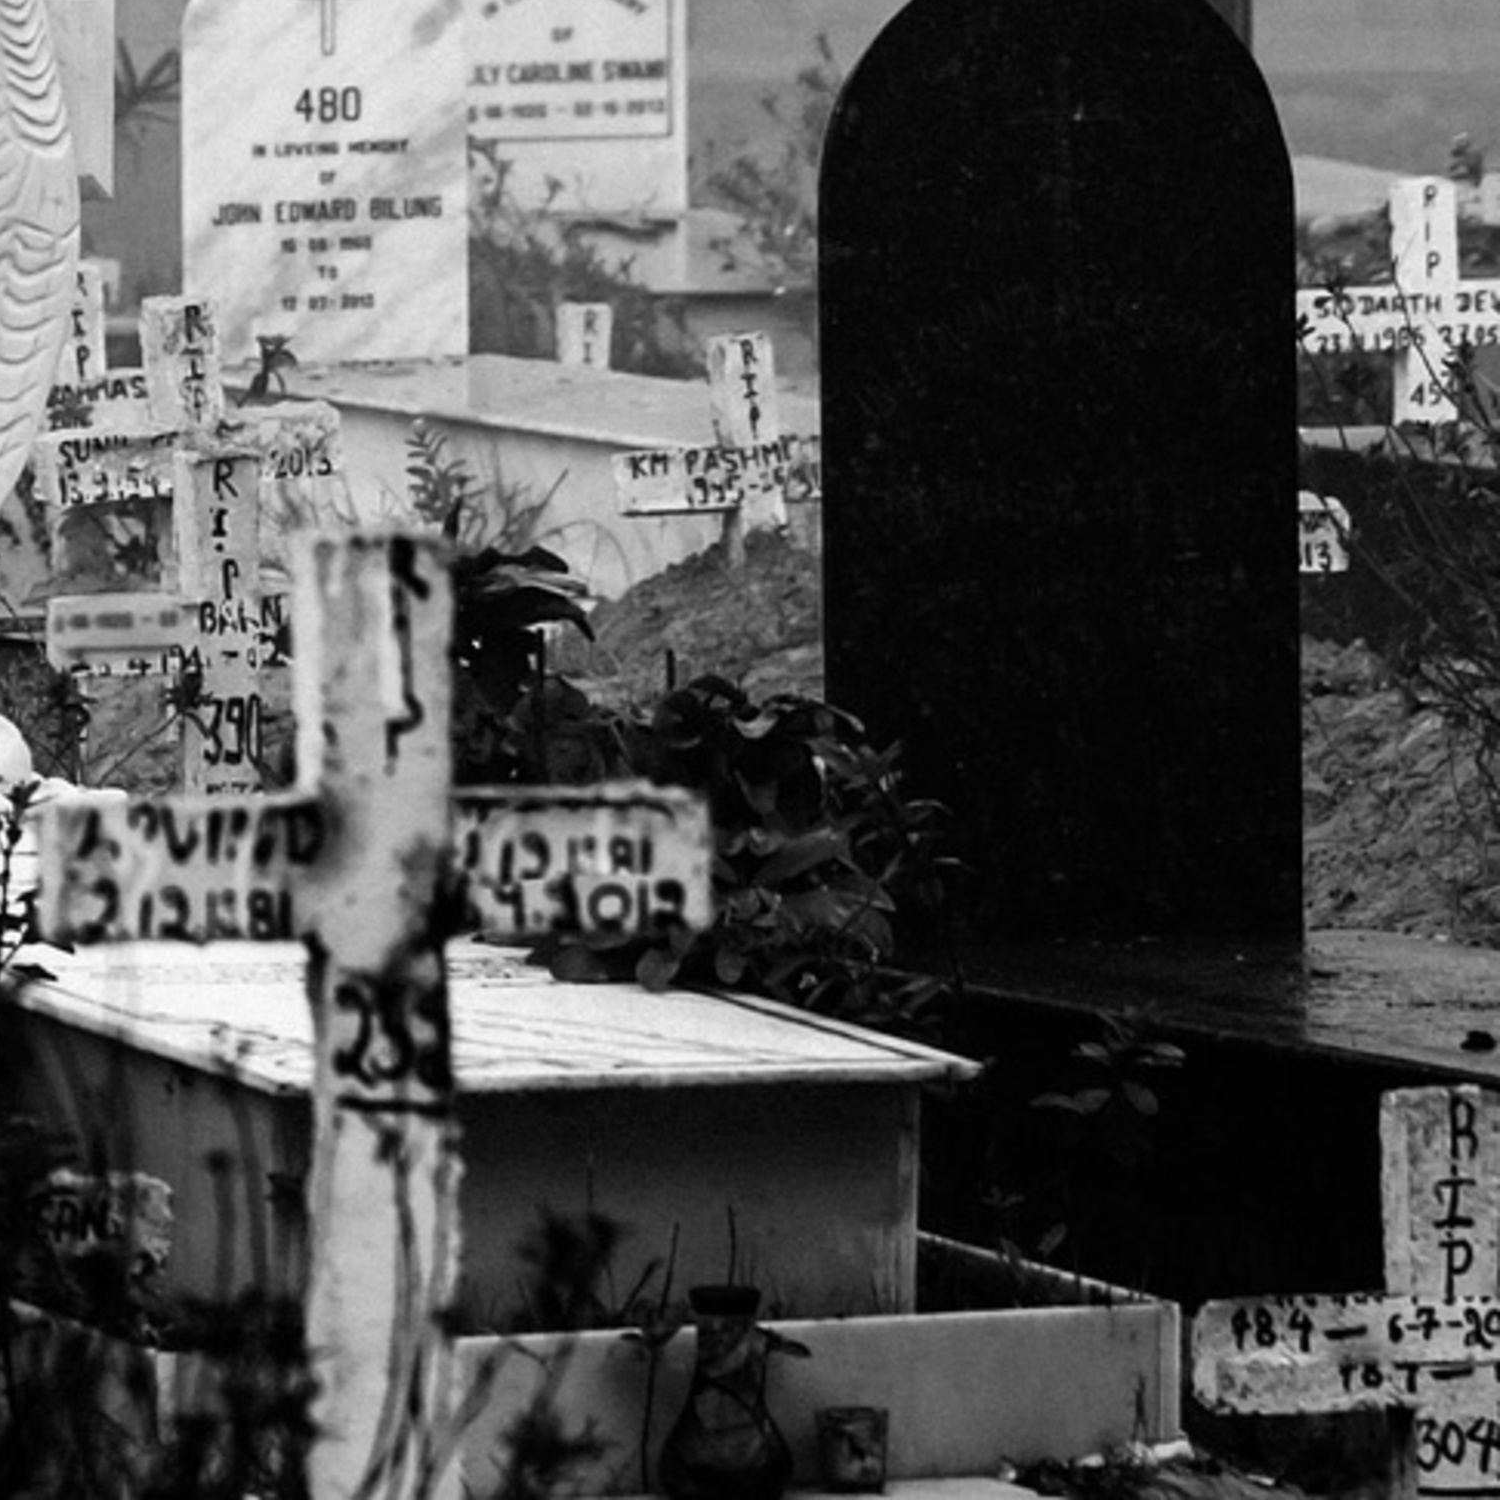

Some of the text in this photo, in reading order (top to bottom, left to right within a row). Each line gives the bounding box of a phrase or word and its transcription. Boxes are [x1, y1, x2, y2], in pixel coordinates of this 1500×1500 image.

[294, 85, 362, 125] 480
[212, 202, 263, 227] JOHN
[274, 198, 357, 225] EDWARD
